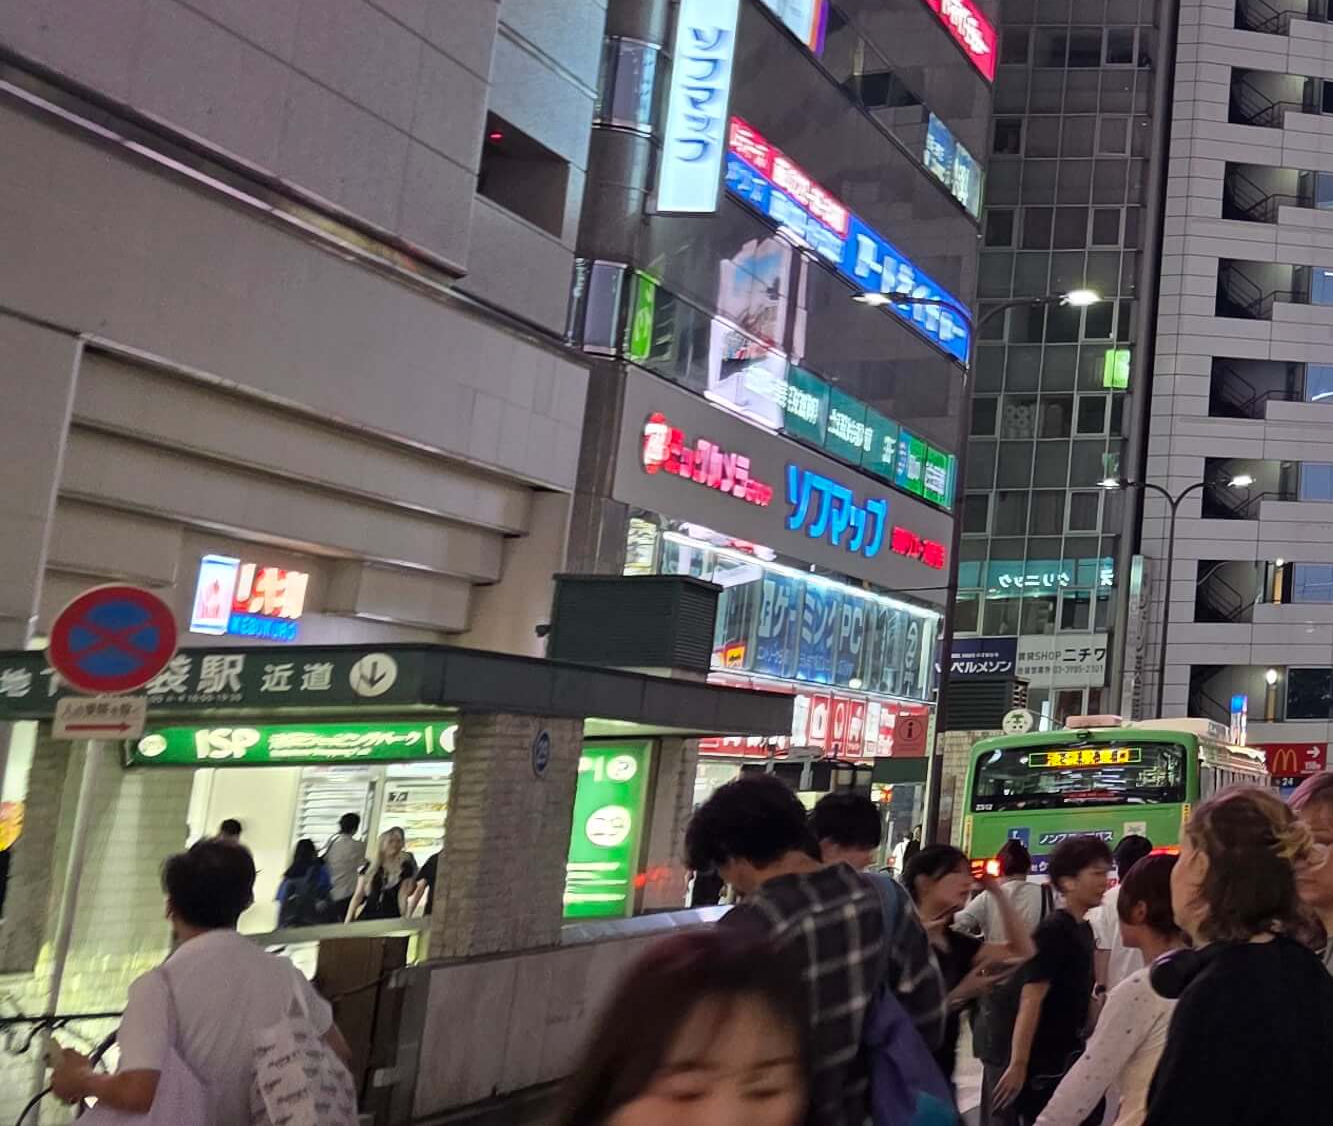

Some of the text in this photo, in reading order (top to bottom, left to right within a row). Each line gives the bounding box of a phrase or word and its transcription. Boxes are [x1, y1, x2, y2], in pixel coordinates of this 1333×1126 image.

[674, 25, 724, 163] ソフマップ
[785, 464, 888, 558] ソフマップ
[1063, 647, 1107, 663] ニチワ
[260, 662, 335, 692] 近道
[194, 728, 261, 760] ISP
